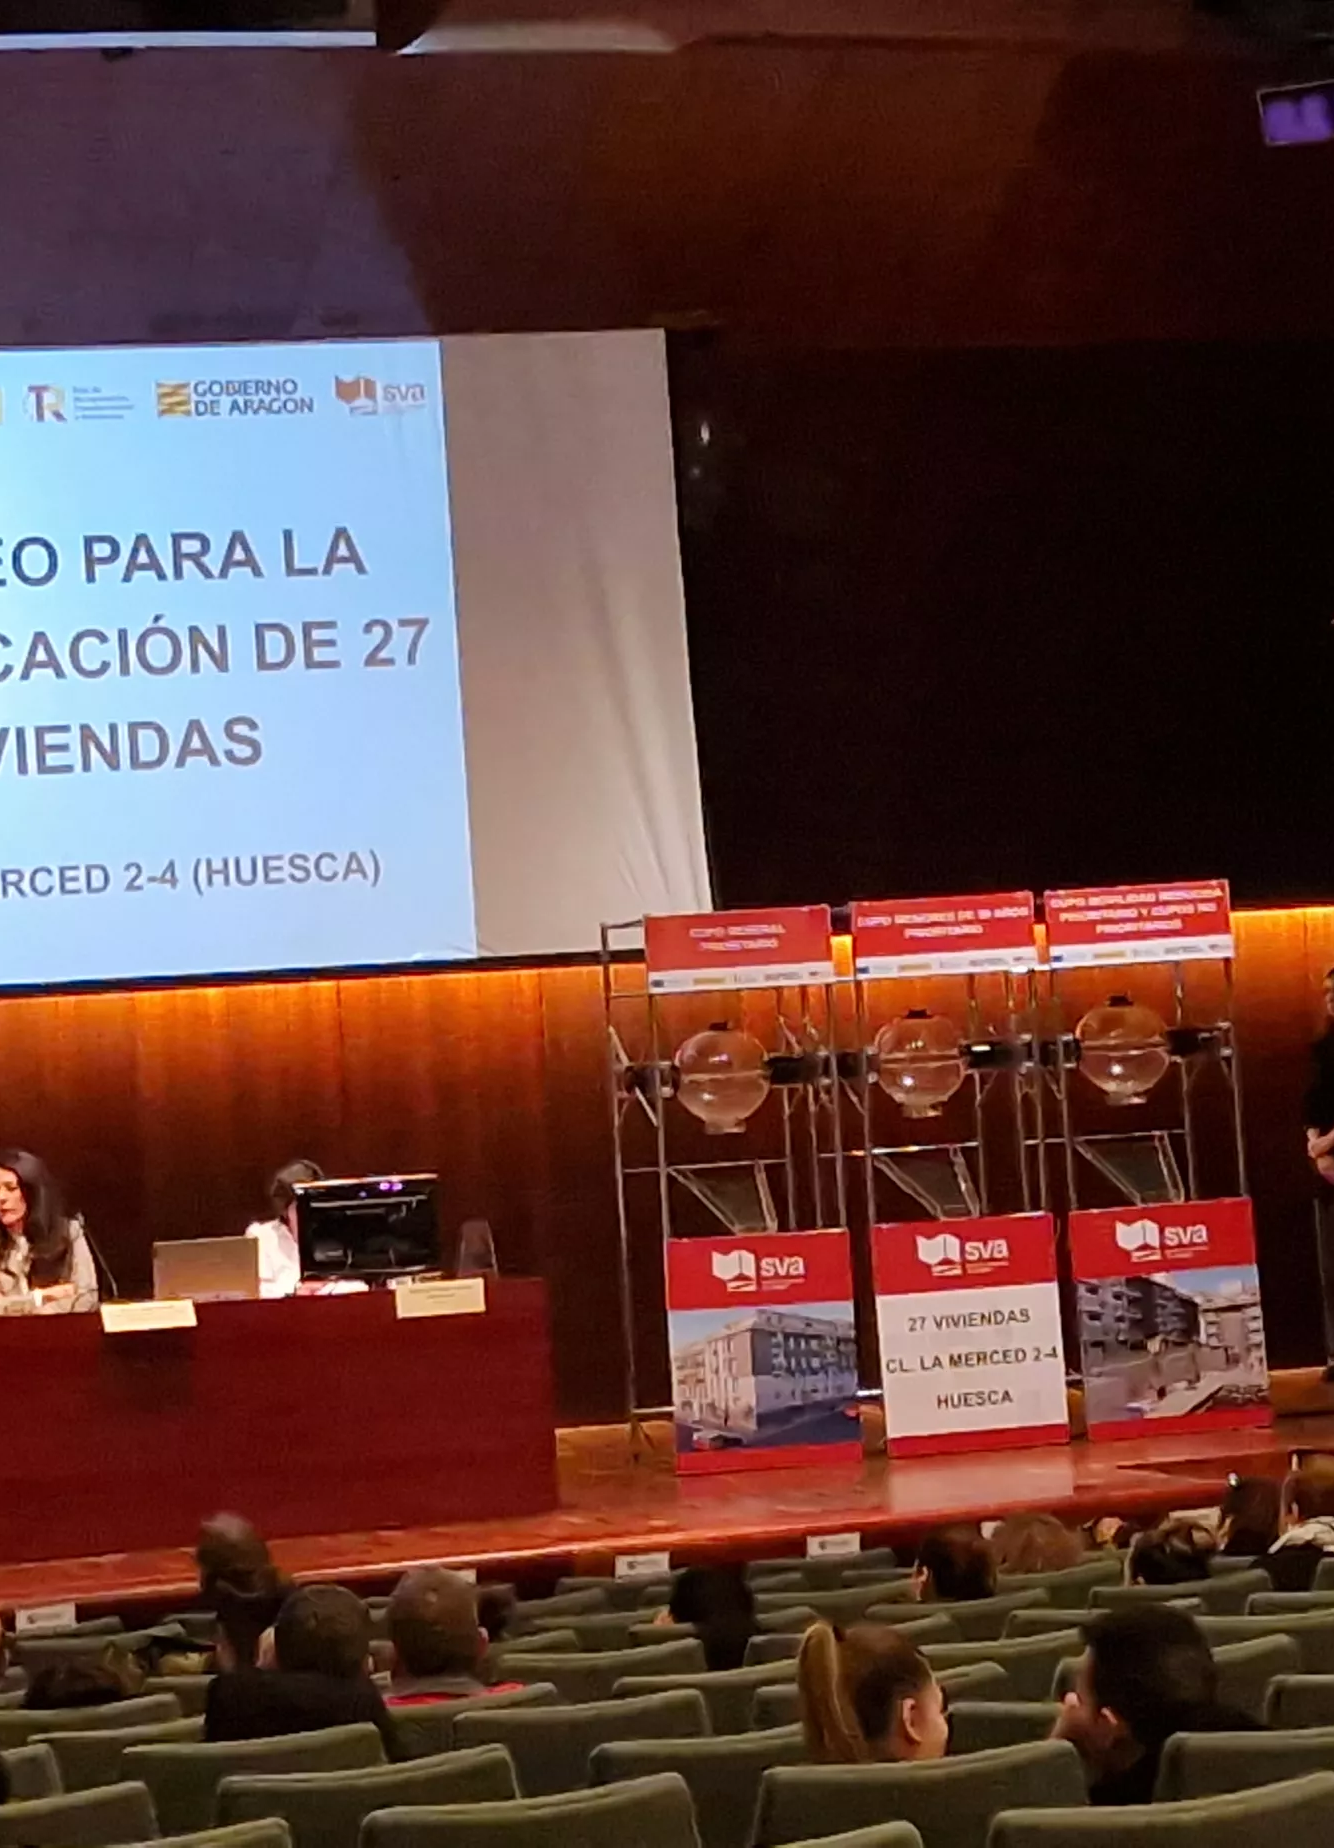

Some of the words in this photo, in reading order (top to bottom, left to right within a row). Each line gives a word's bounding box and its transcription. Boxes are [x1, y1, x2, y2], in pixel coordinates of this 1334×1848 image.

[193, 378, 298, 397] GOBIERNO
[194, 400, 220, 416] DE
[82, 529, 265, 584] PARA
[281, 525, 369, 578] LA
[254, 619, 342, 672] DE
[363, 617, 431, 668] 27
[123, 858, 179, 893] 2-4
[191, 849, 383, 896] (HUESCA)
[1164, 1224, 1209, 1247] sva
[964, 1238, 1009, 1260] sva
[759, 1255, 805, 1277] sva
[907, 1316, 926, 1332] 27
[932, 1308, 1032, 1331] VIVIENDAS
[919, 1355, 944, 1371] LA
[948, 1347, 1027, 1369] MERCED
[936, 1389, 1014, 1409] HUESCA
